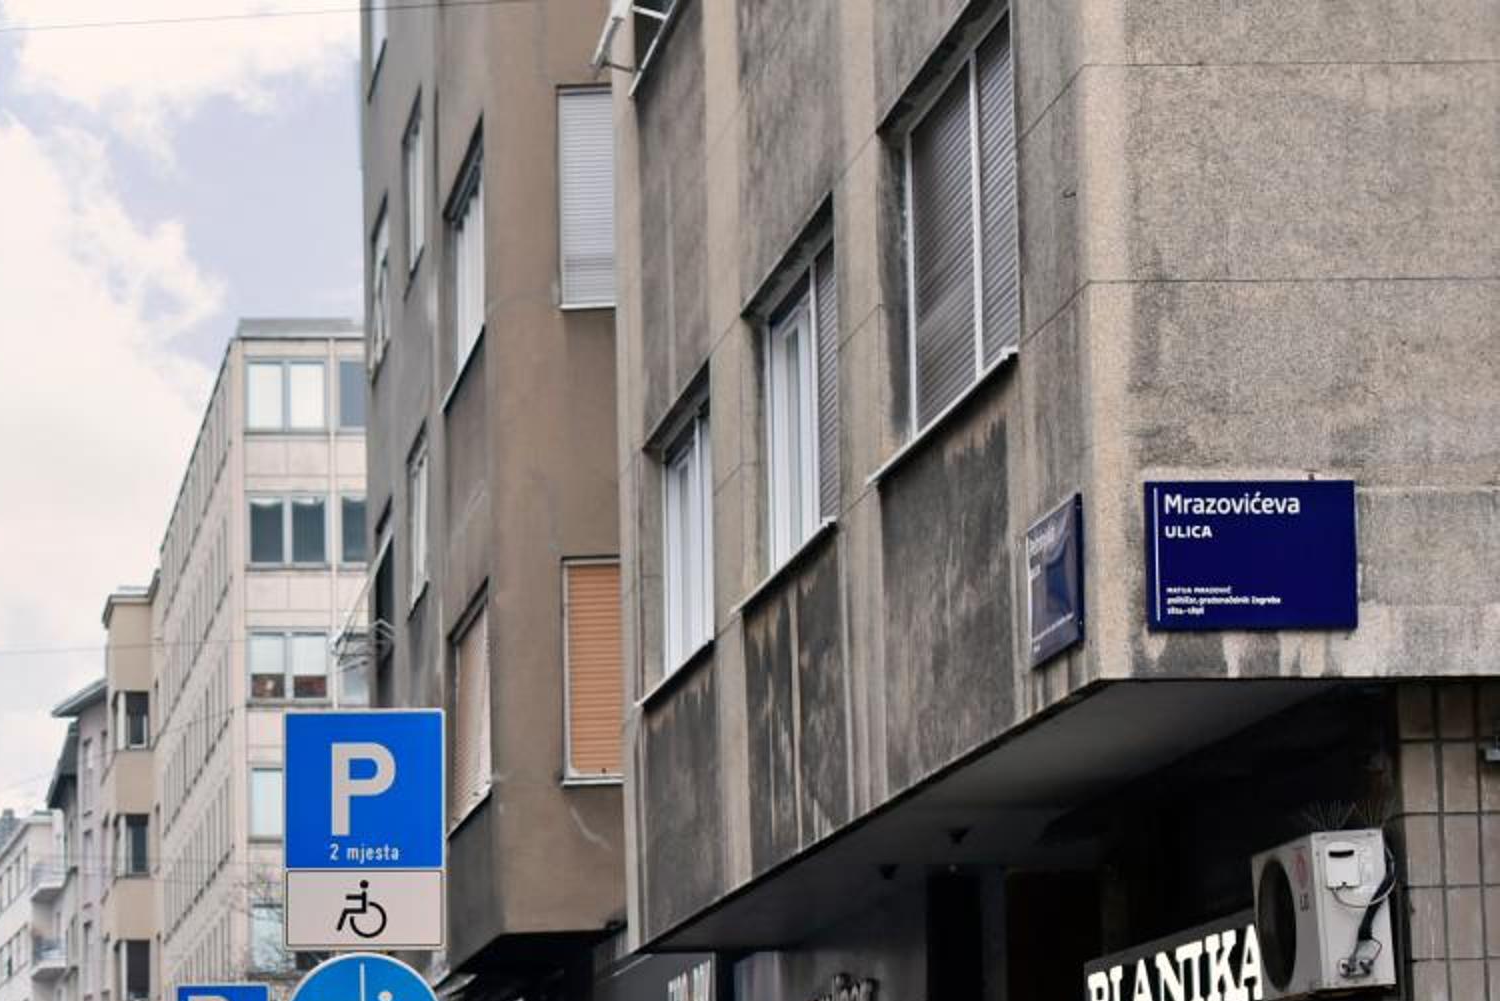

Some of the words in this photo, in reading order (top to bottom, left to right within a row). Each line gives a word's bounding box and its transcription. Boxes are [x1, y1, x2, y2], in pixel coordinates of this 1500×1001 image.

[1164, 491, 1300, 515] Mrazovićeva
[1165, 525, 1213, 538] ULICA
[331, 742, 396, 836] P
[329, 843, 339, 861] 2
[346, 843, 399, 865] mjesta
